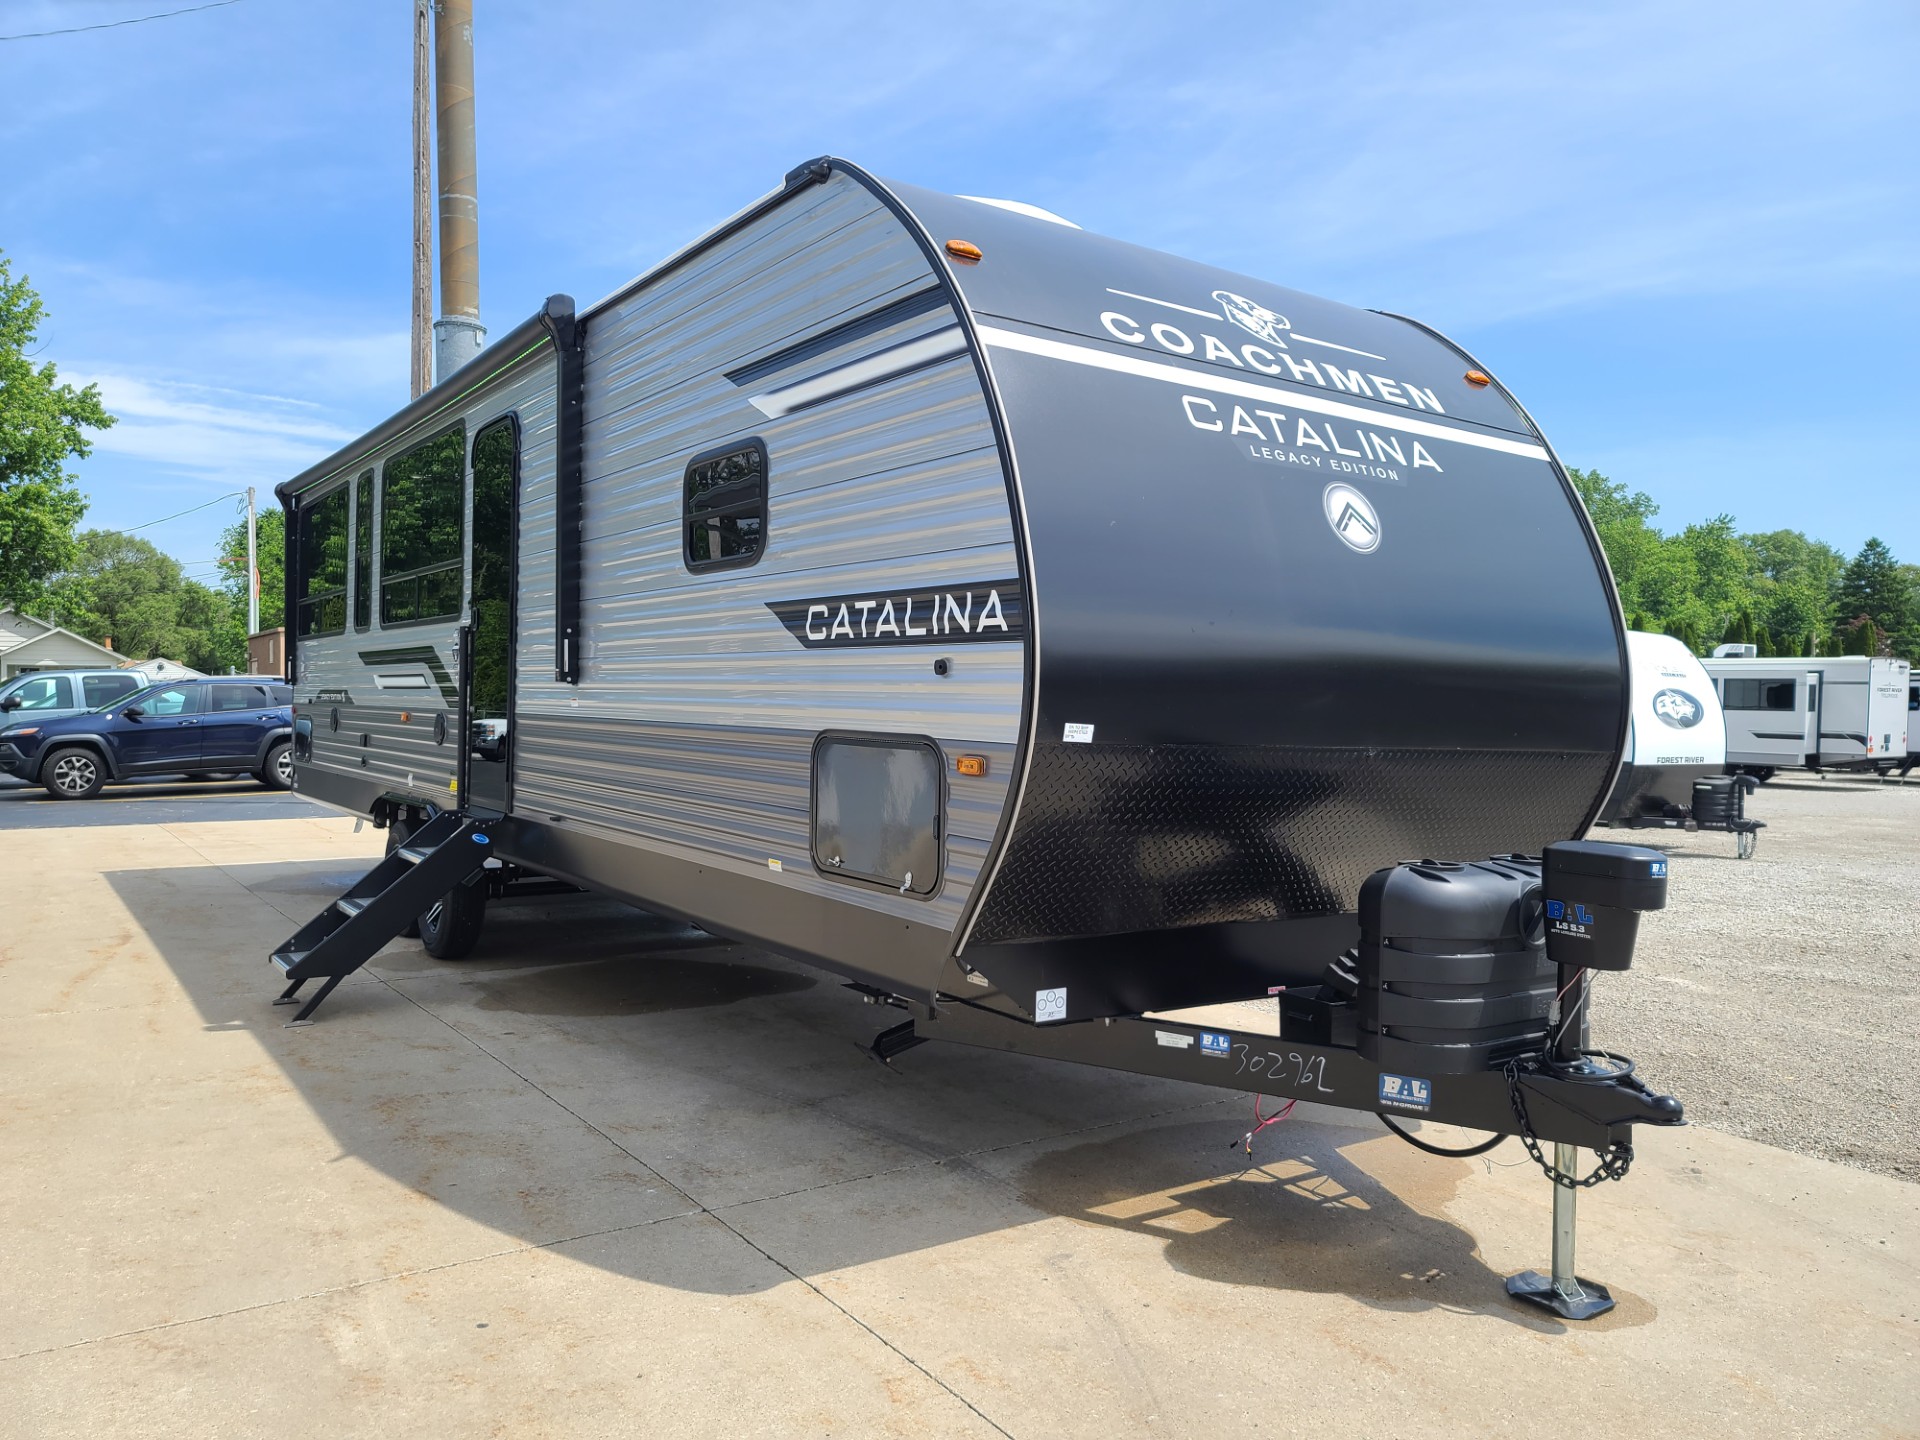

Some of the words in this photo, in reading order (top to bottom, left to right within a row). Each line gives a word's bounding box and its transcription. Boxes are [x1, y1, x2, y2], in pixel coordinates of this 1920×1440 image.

[1100, 311, 1446, 414] COACHMEN
[1181, 394, 1444, 473] CATALINA
[1249, 444, 1324, 468] LEGACY
[1329, 459, 1400, 481] EDITION
[805, 589, 1009, 641] CATALINA
[1656, 756, 1683, 764] FOREST
[1555, 920, 1569, 930] LS
[1570, 923, 1585, 933] 5.3
[1202, 1034, 1229, 1048] BAL
[1383, 1075, 1428, 1098] BAL
